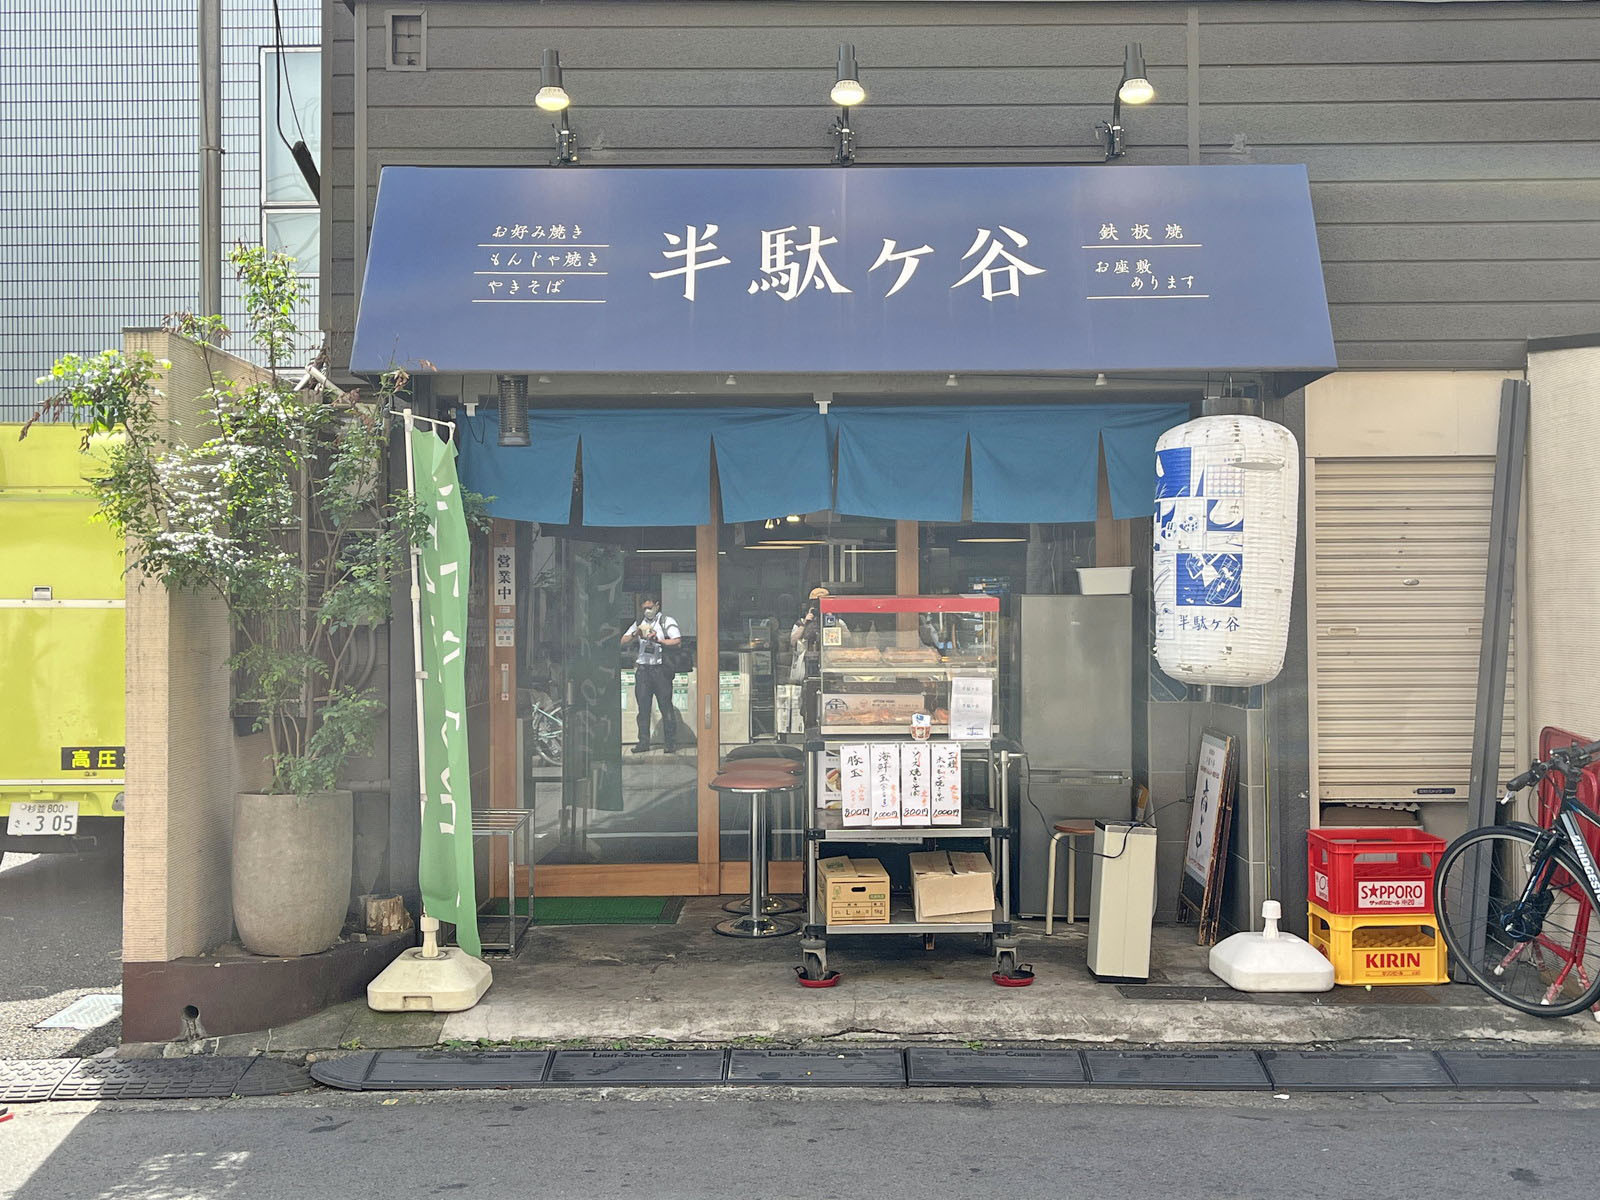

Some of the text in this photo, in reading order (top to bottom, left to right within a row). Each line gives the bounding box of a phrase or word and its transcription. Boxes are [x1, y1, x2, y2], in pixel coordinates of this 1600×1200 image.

[492, 223, 582, 240] お好み焼き
[1099, 222, 1184, 241] 鉄板焼
[490, 251, 598, 268] もんじゃ焼き
[1095, 258, 1153, 274] お座敷
[487, 279, 565, 295] やきそば
[1131, 275, 1195, 290] あります
[497, 554, 512, 600] 営業中
[71, 749, 125, 768] 高圧
[1365, 953, 1421, 969] KIRIN
